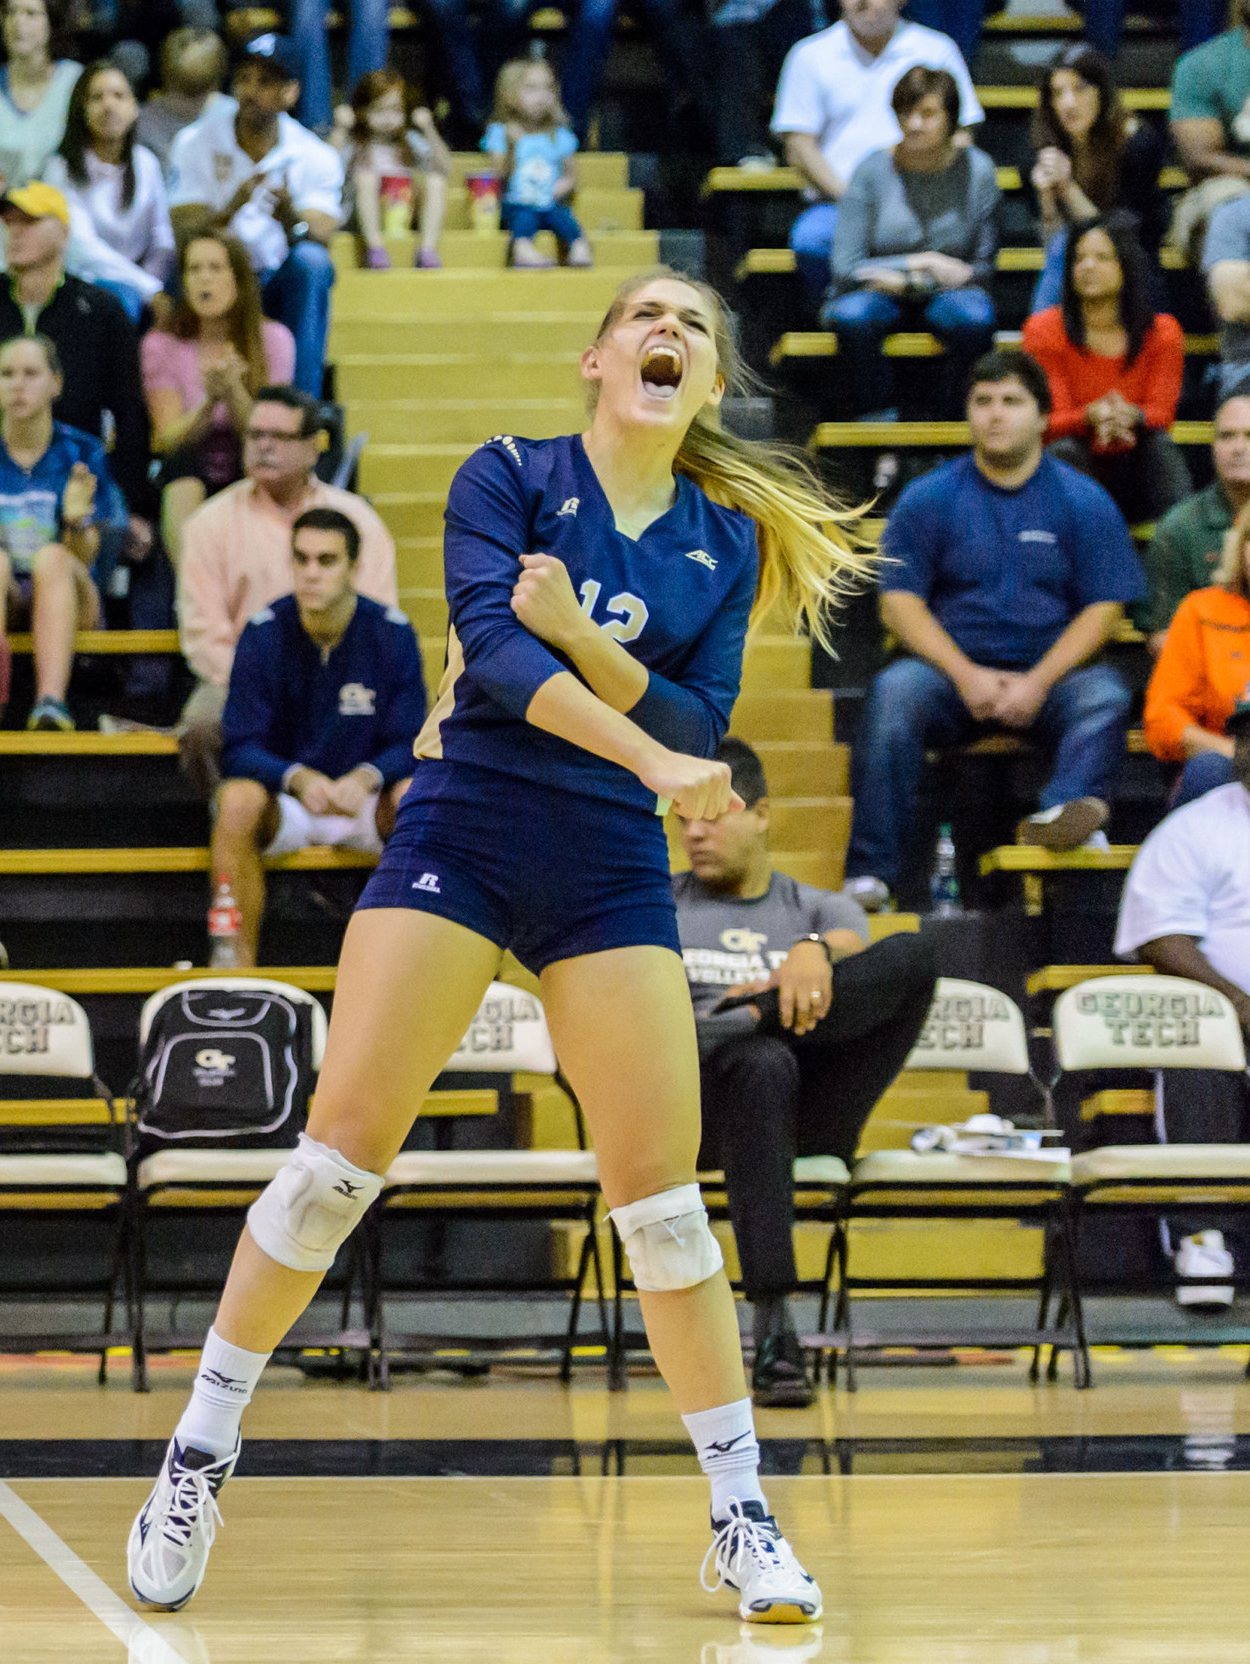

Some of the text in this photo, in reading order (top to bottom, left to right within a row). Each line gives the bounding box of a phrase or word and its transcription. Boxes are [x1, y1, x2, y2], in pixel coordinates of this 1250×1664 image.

[685, 549, 718, 571] ACC
[579, 578, 649, 644] 12
[1077, 992, 1225, 1018] GEORGIA
[918, 1022, 985, 1051] ECH
[1105, 1019, 1200, 1047] TECH
